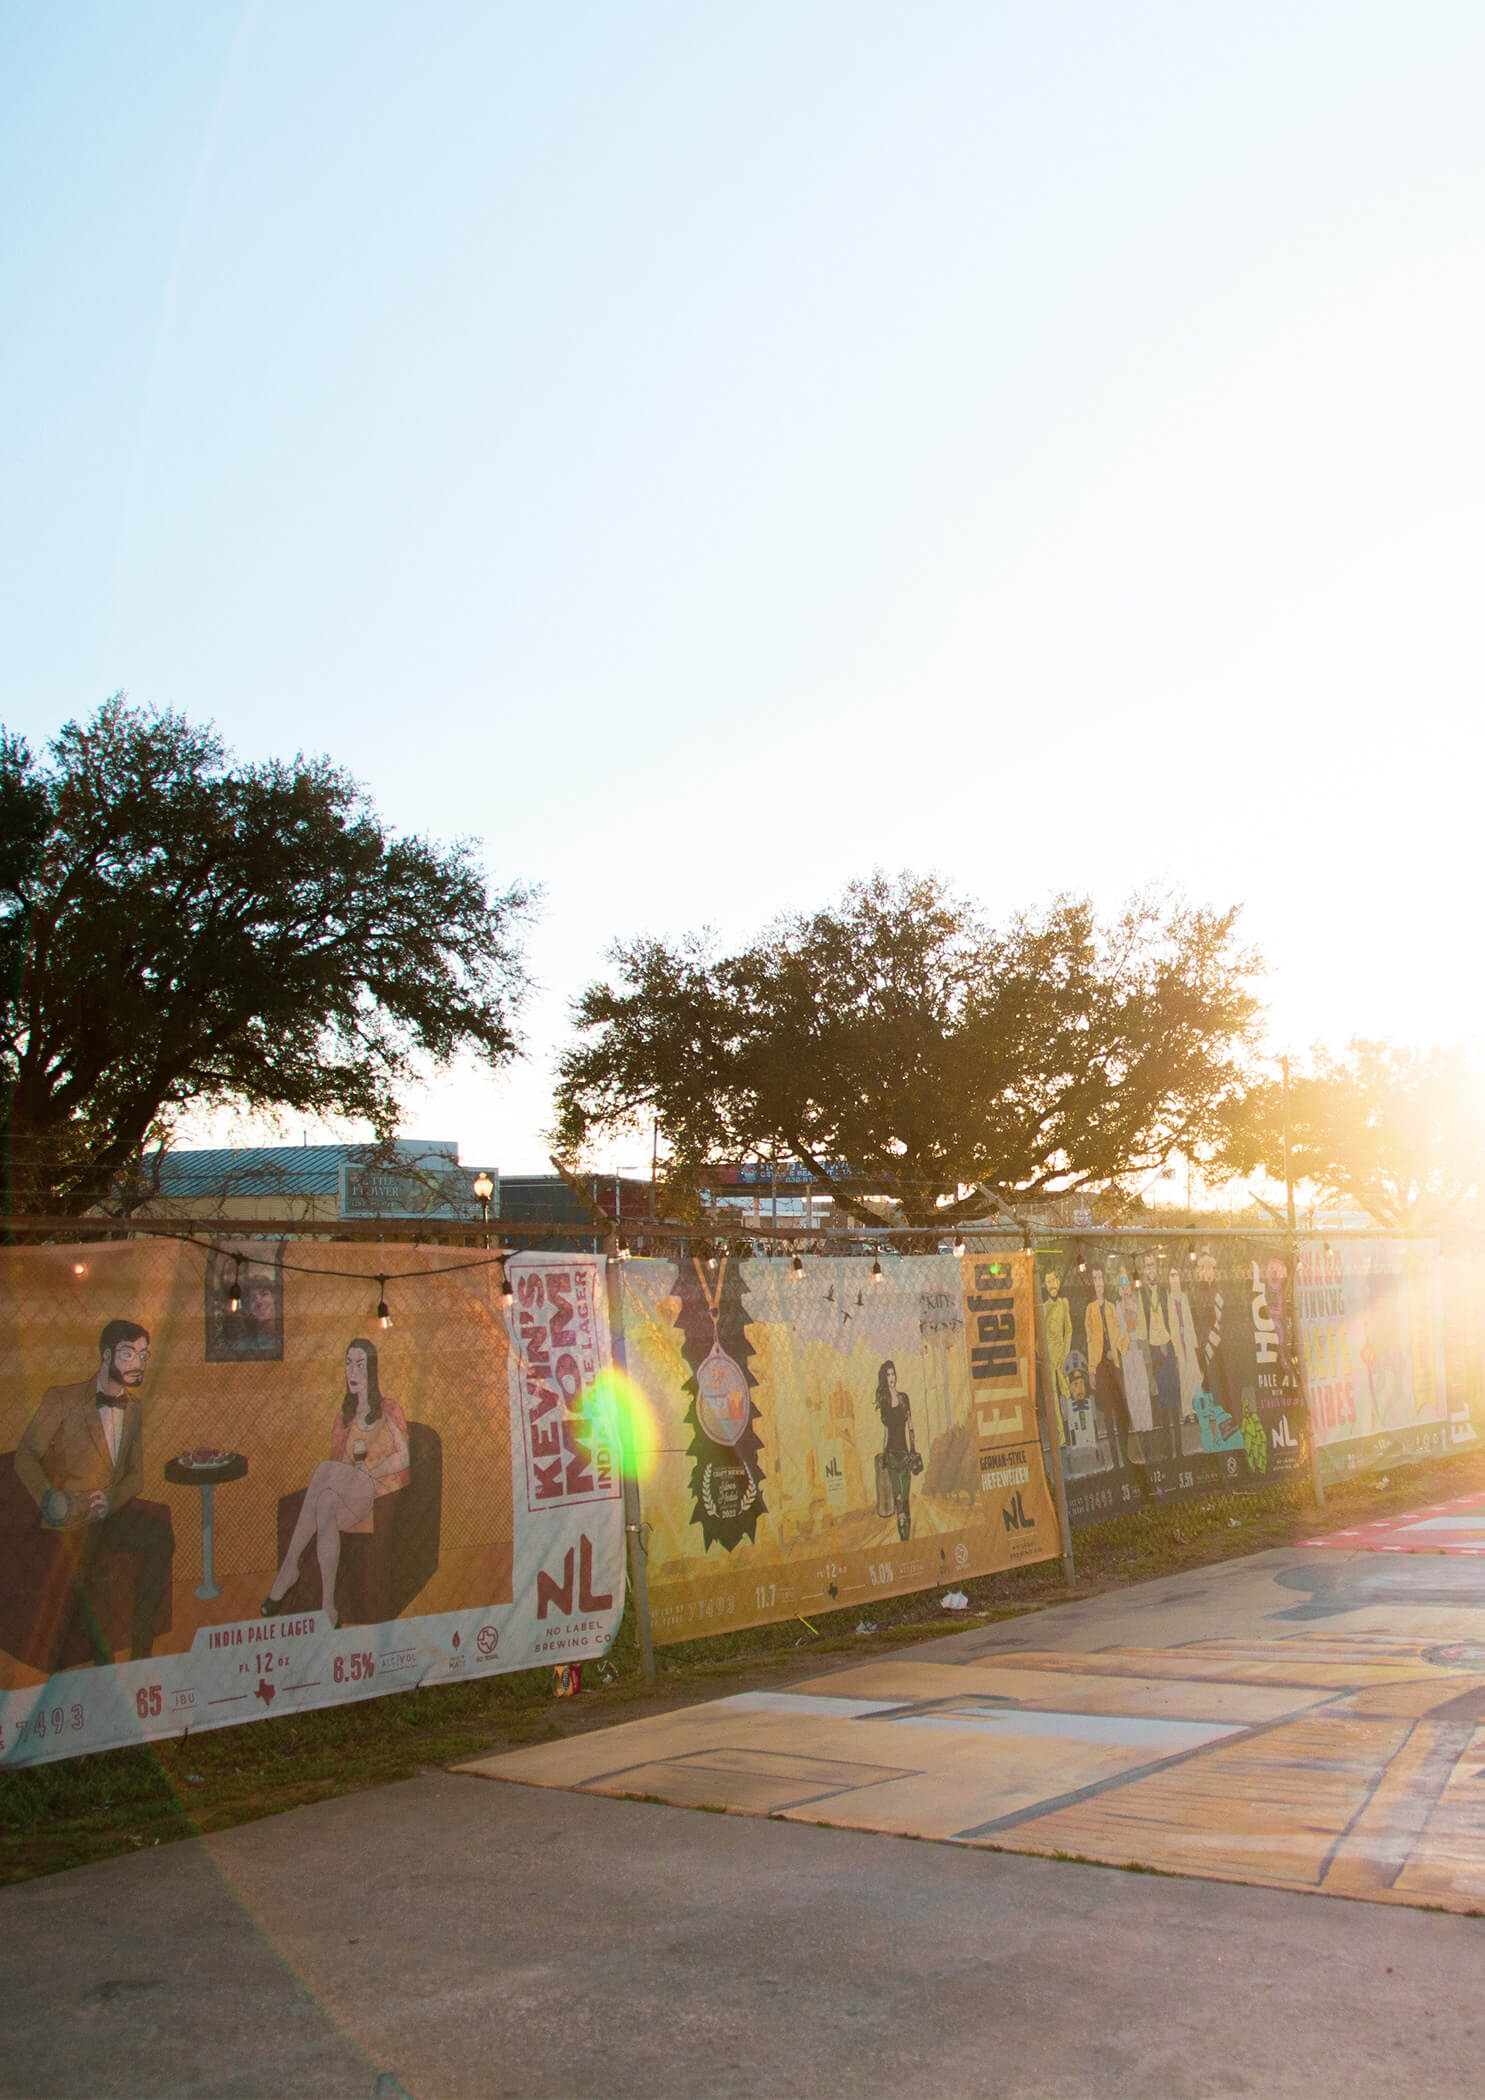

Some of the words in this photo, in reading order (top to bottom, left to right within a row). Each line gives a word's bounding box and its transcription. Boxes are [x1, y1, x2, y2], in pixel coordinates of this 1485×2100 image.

[574, 1271, 593, 1351] LAGER
[967, 1263, 1018, 1380] Hefe
[517, 1272, 564, 1500] KEVIN'S
[544, 1272, 595, 1496] MOM
[1272, 1414, 1298, 1448] NL
[595, 1426, 612, 1490] INDI
[980, 1450, 1027, 1471] GERMAN-STYLE
[1002, 1490, 1035, 1532] NL
[537, 1533, 613, 1620] NL
[209, 1628, 243, 1649] INDIA
[248, 1623, 276, 1643] PALE
[281, 1618, 316, 1638] LAGER
[535, 1636, 588, 1653] BREWING
[595, 1634, 612, 1644] CO
[546, 1626, 561, 1637] NO
[566, 1621, 603, 1633] LABEL
[256, 1652, 274, 1674] 12
[333, 1651, 375, 1684] 6.5%
[136, 1684, 162, 1719] 65
[175, 1693, 196, 1706] IBU
